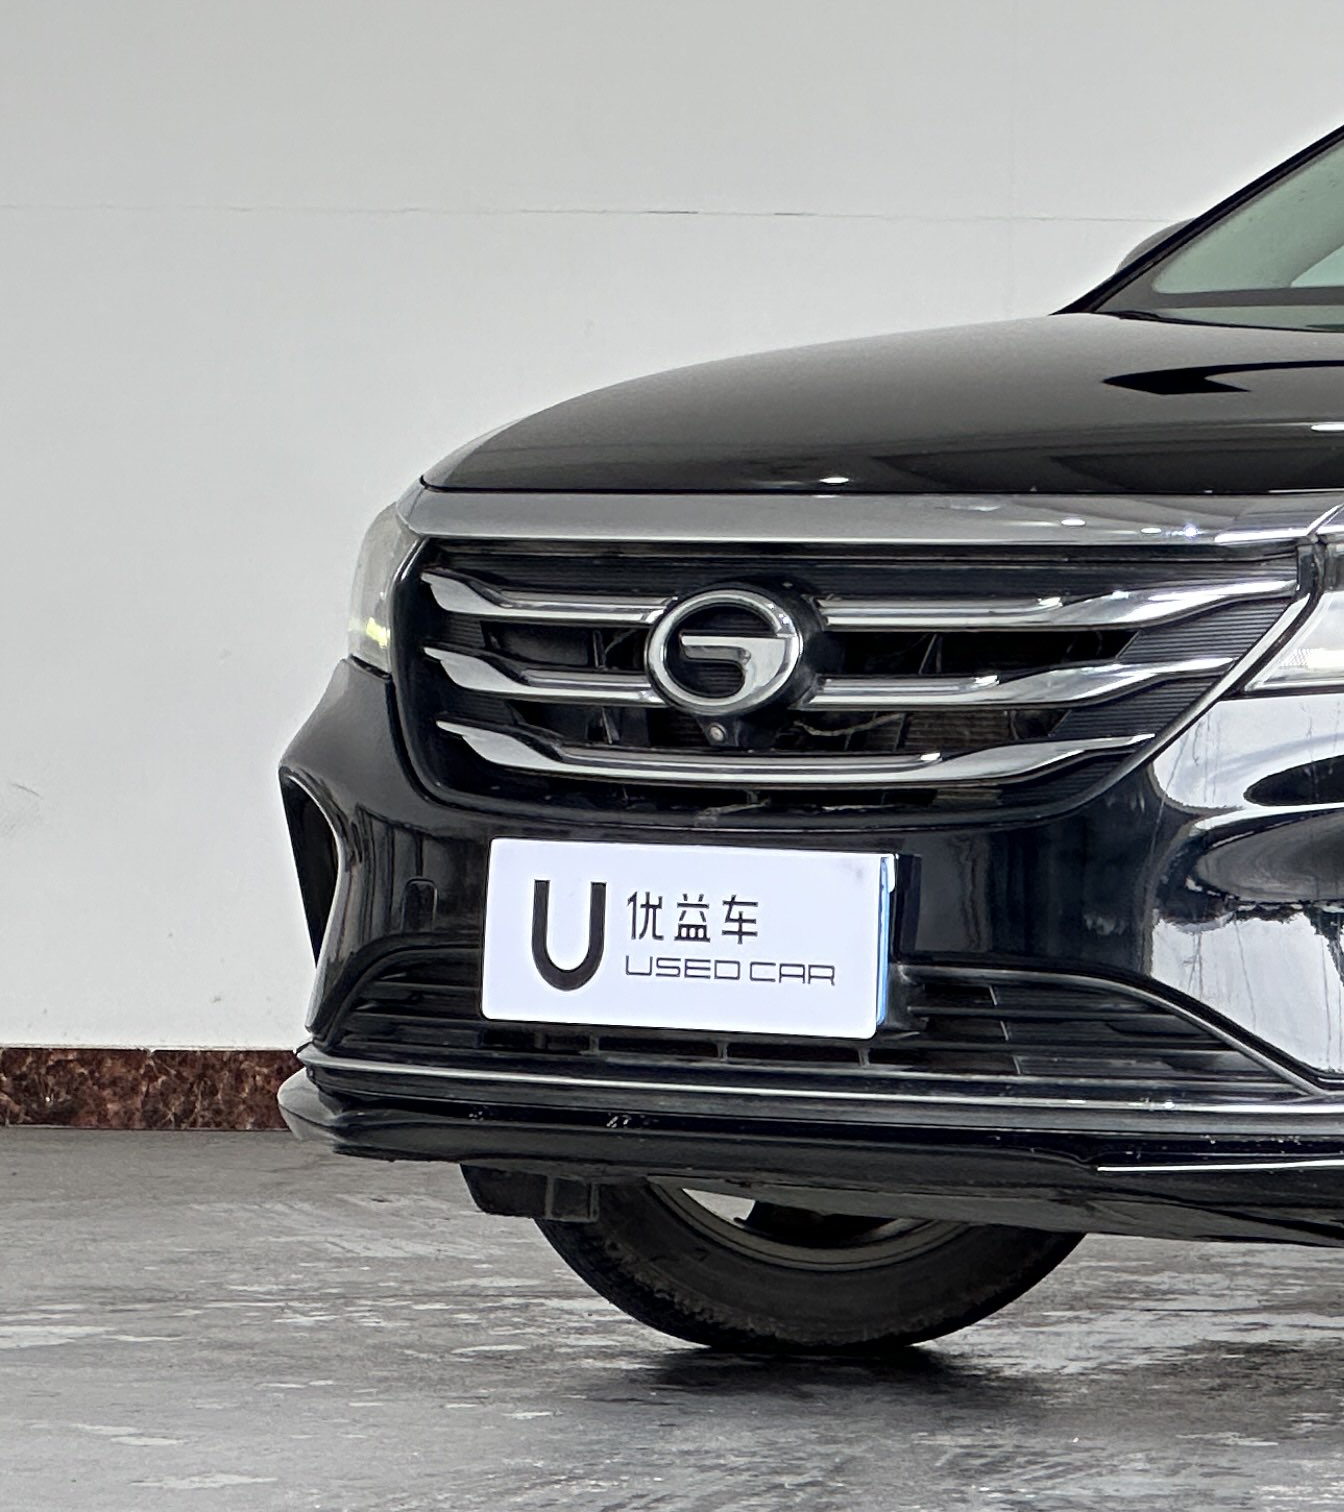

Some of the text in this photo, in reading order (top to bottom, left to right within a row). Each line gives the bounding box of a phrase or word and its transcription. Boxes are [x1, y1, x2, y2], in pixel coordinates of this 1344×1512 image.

[531, 878, 607, 992] U
[626, 890, 759, 945] 优益车
[625, 955, 836, 986] USED CAR
